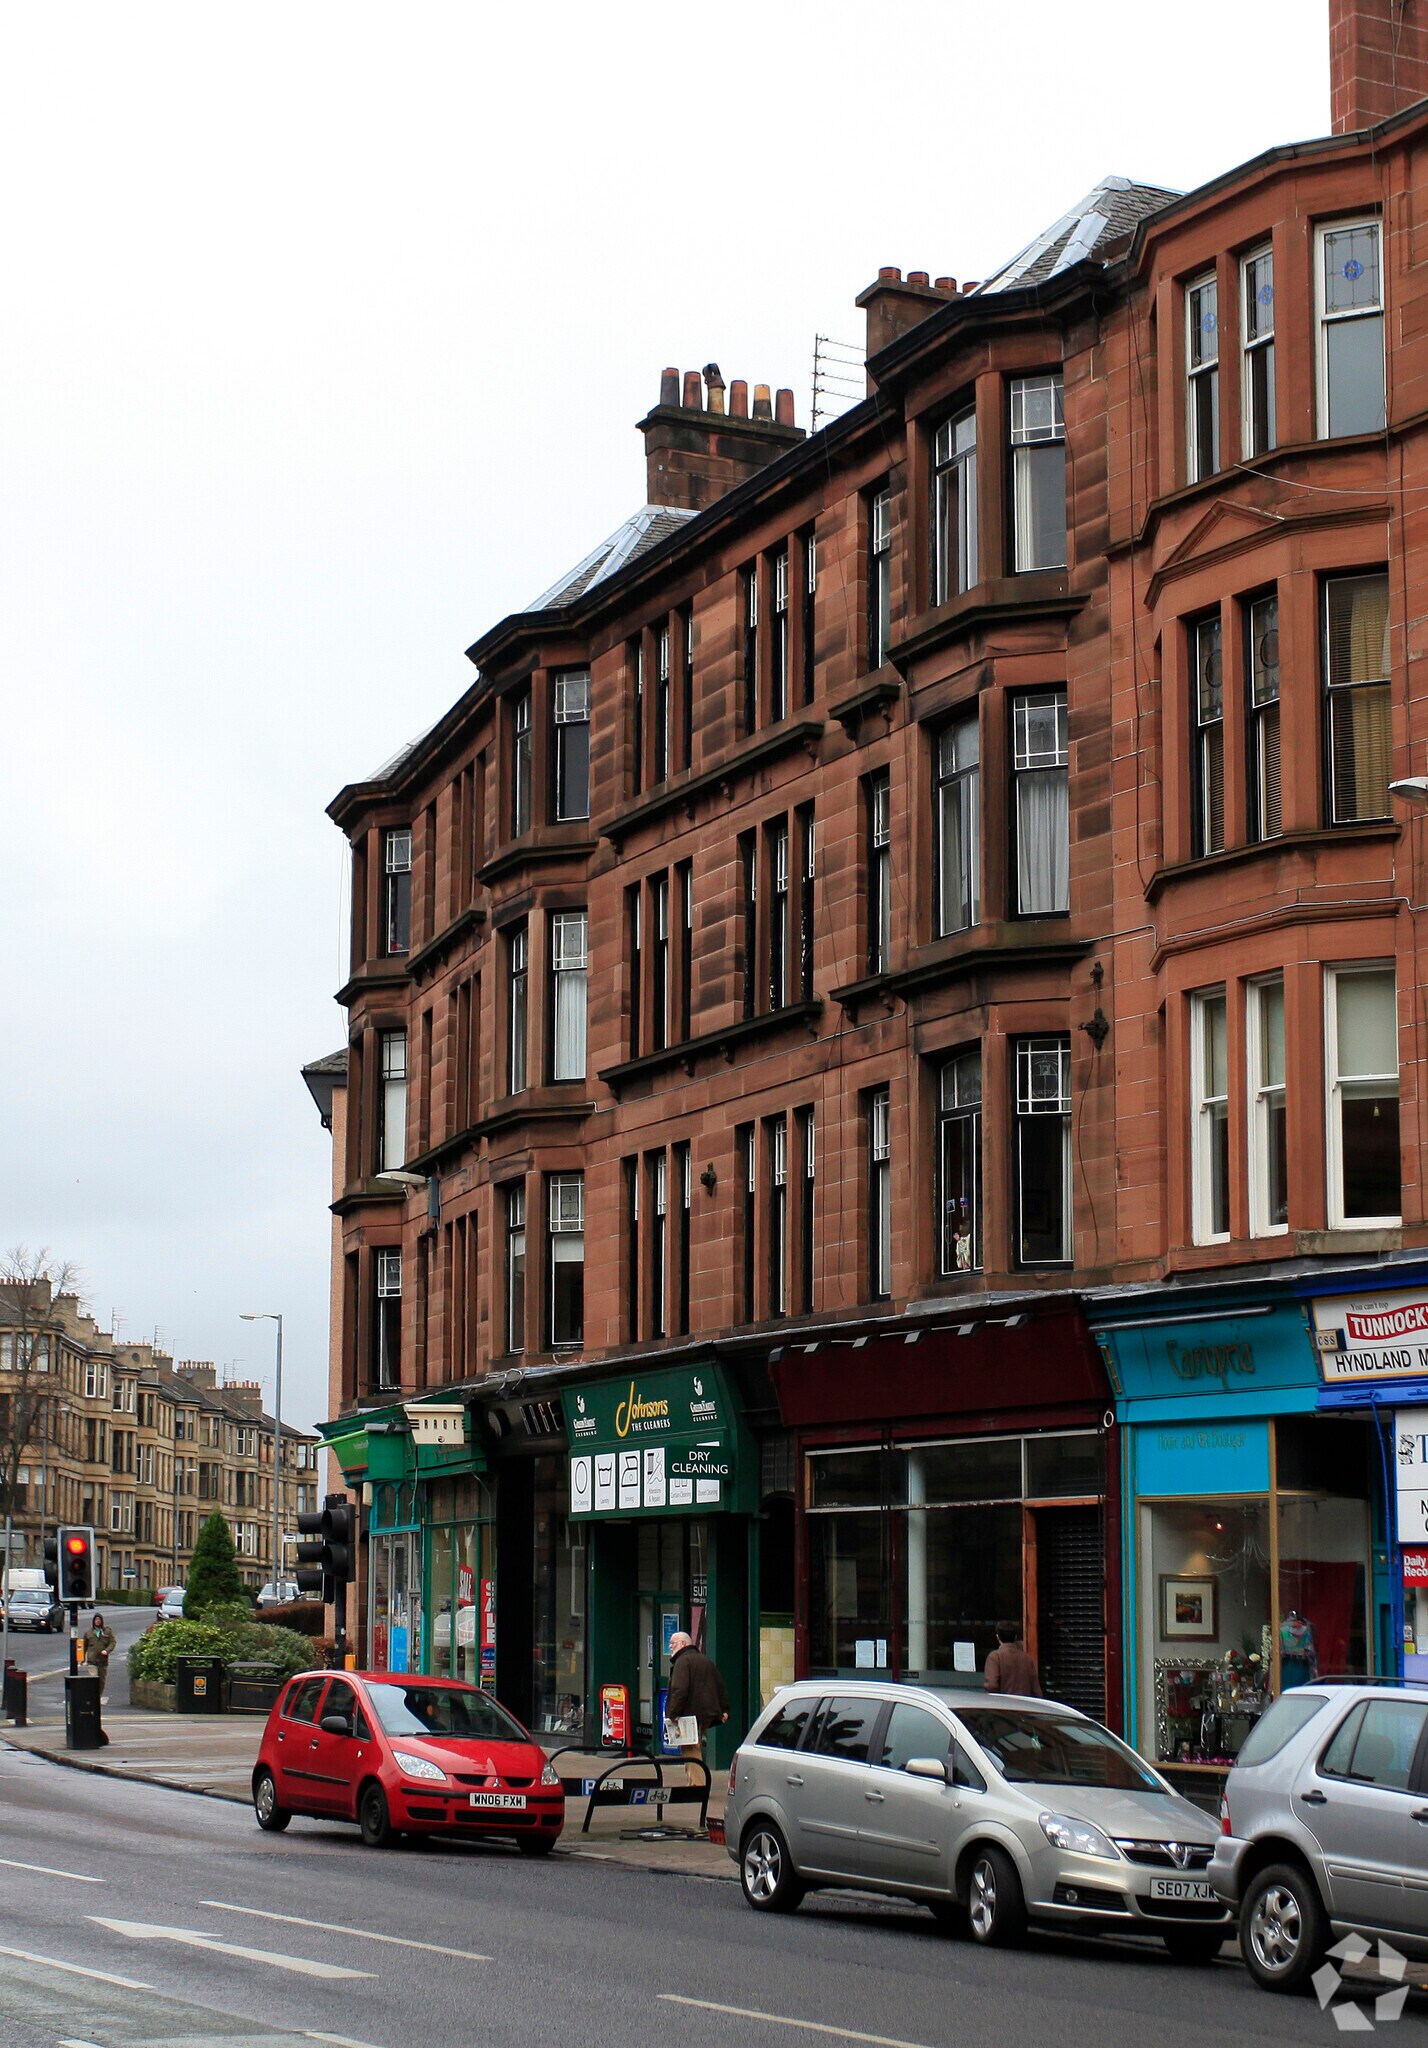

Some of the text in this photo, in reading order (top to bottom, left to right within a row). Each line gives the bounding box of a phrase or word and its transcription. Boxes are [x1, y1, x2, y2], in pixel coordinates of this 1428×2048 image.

[1350, 1301, 1389, 1311] You can't top
[1335, 1350, 1412, 1373] HYNDLAND
[615, 1381, 669, 1438] Johnsons
[424, 1419, 457, 1430] RAGE
[632, 1418, 671, 1432] THE CLEANERS
[688, 1451, 711, 1461] DRY
[671, 1463, 729, 1474] CLEANING
[1403, 1555, 1426, 1568] Daily
[585, 1779, 596, 1795] P
[474, 1794, 500, 1806] WN06
[633, 1789, 645, 1804] P
[1157, 1881, 1190, 1897] SE07
